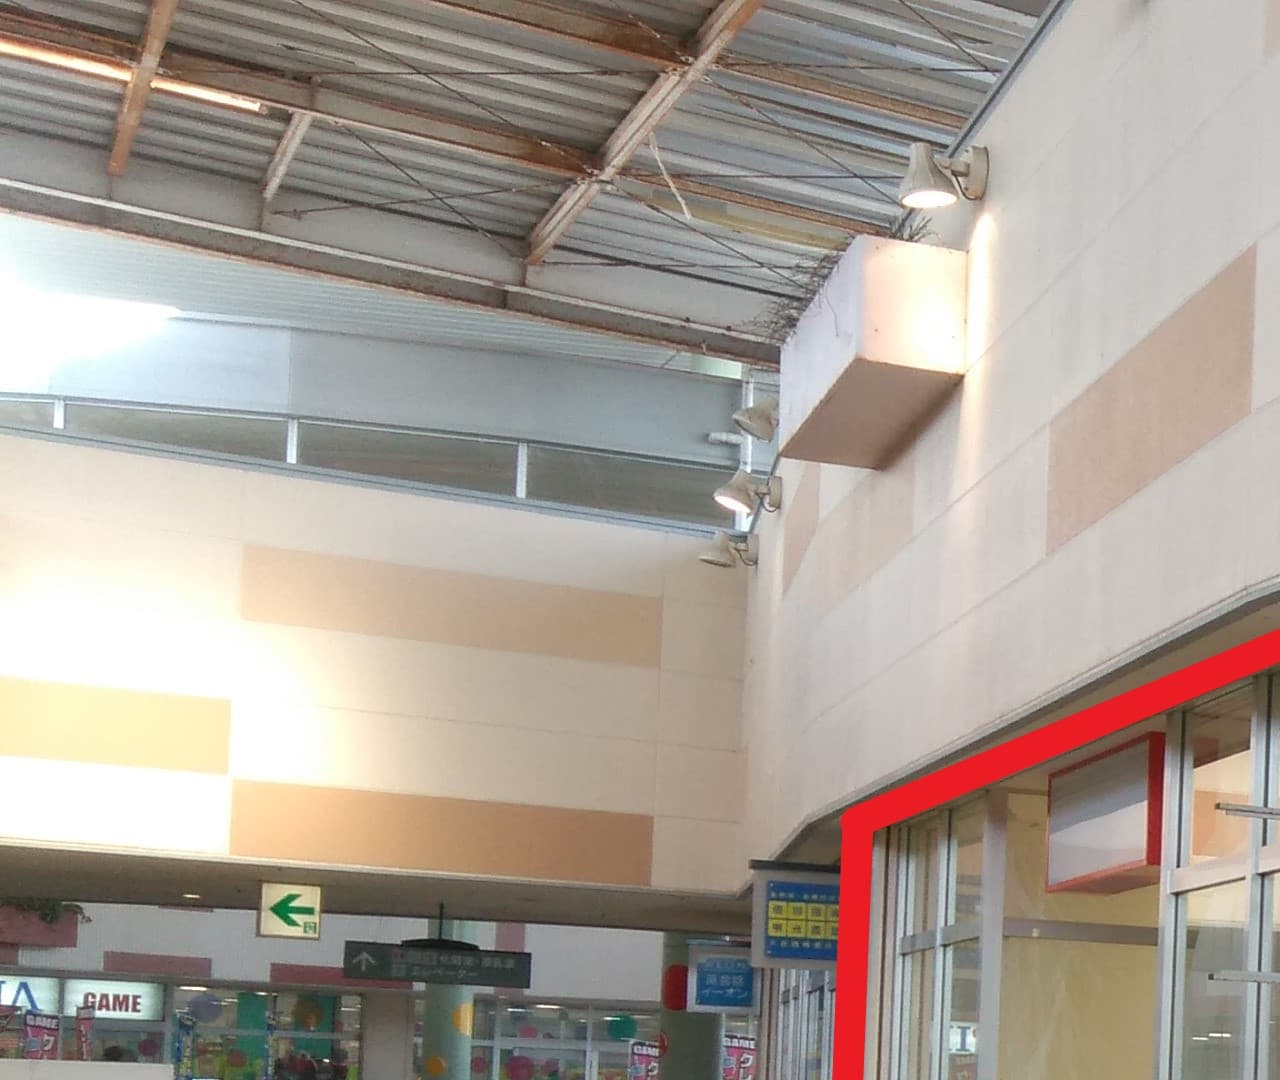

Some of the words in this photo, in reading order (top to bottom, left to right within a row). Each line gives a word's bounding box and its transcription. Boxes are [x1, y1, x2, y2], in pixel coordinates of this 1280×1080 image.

[83, 991, 142, 1013] GAME
[26, 1014, 59, 1030] GAME
[722, 1037, 756, 1049] GAME
